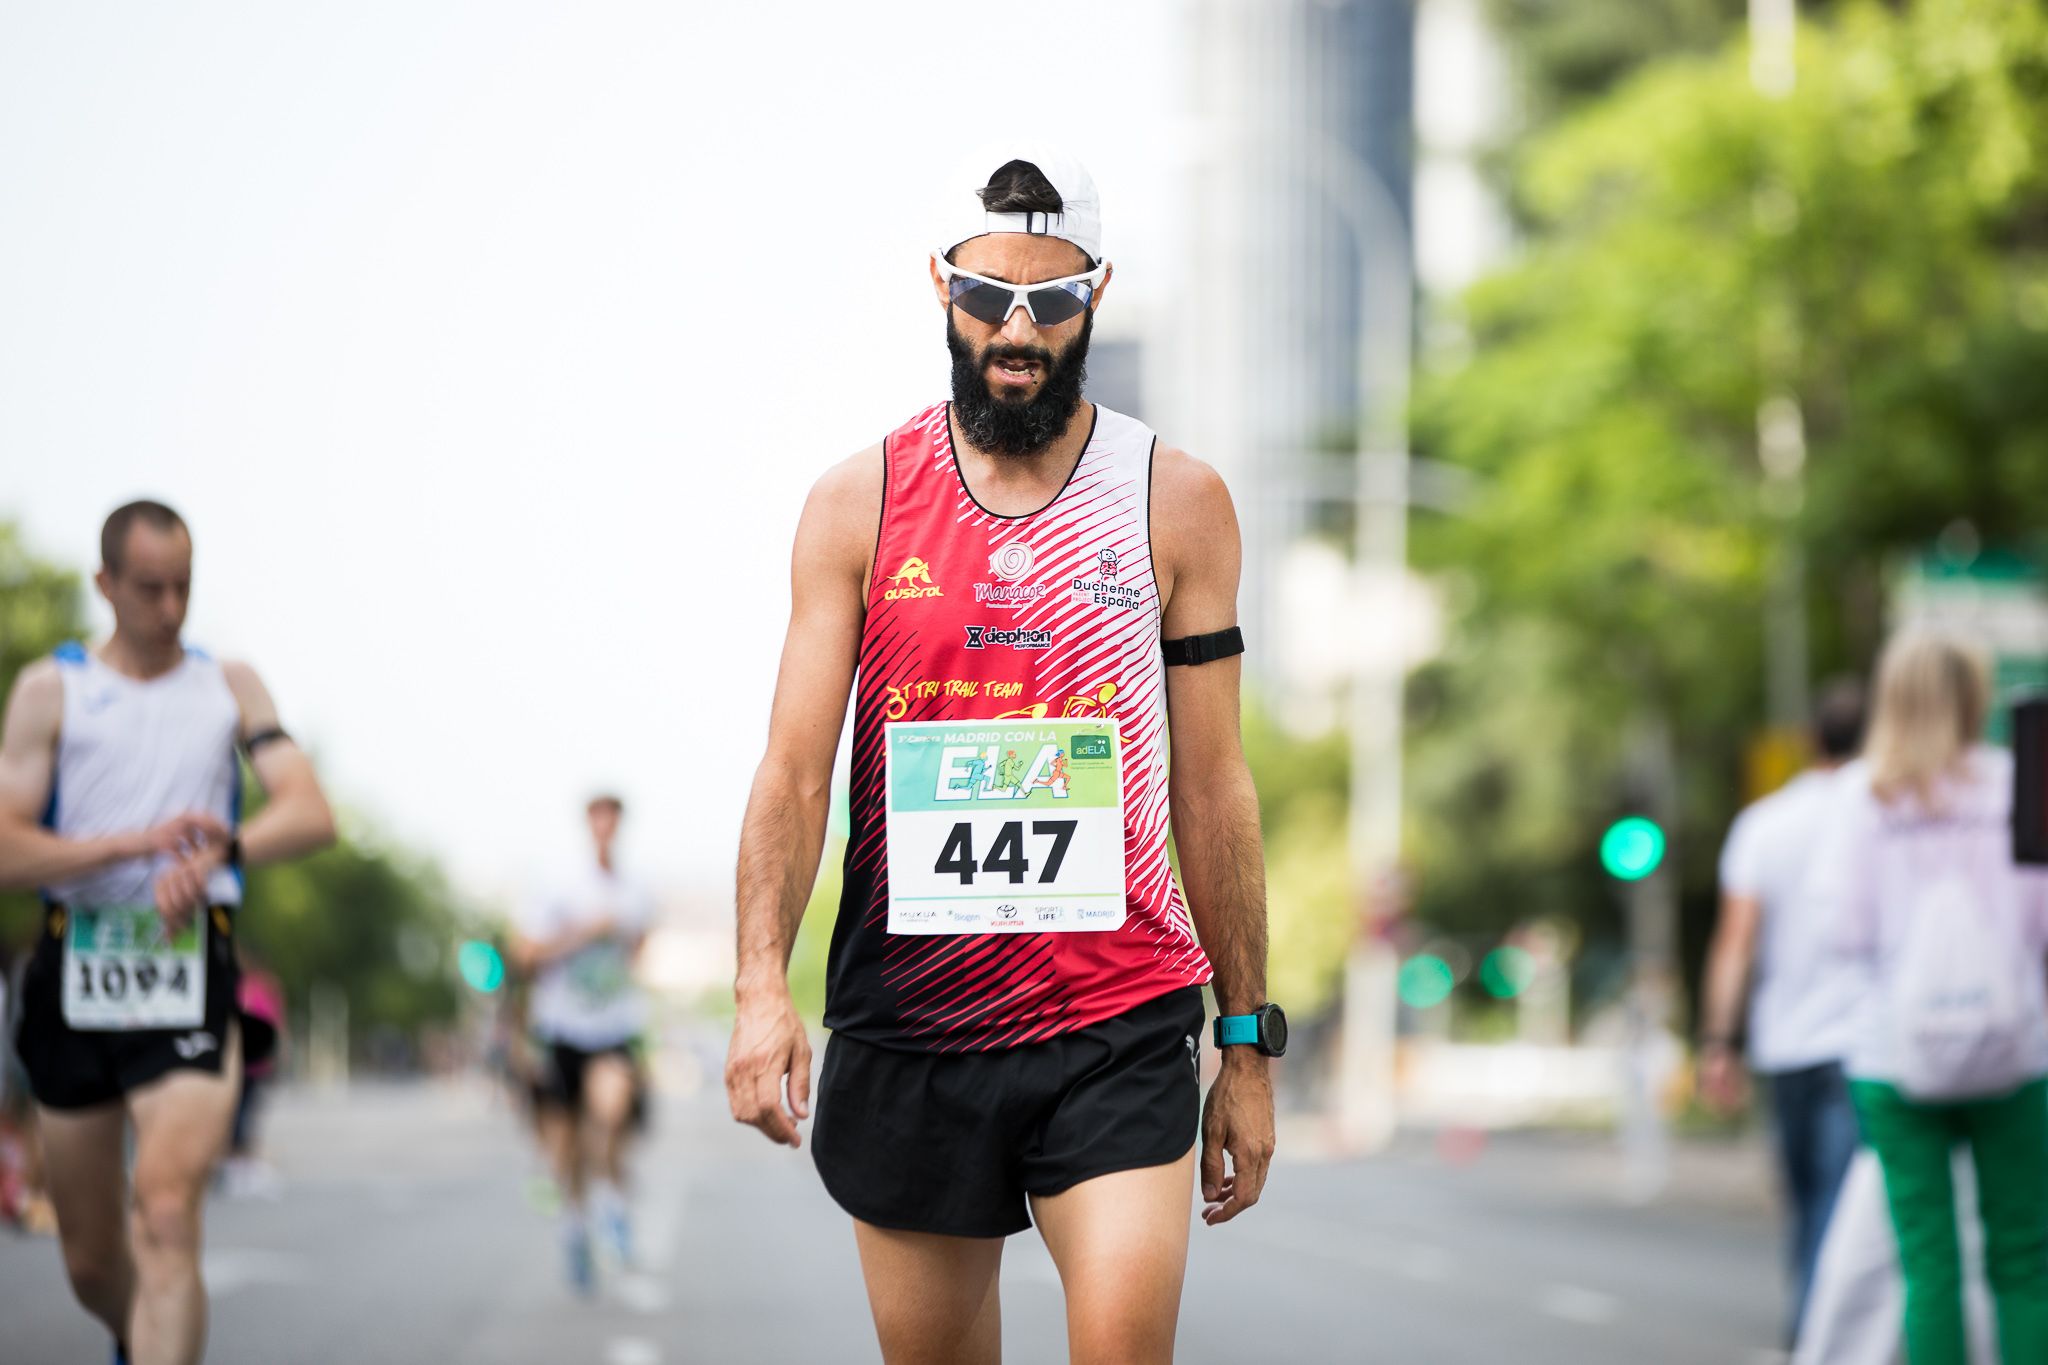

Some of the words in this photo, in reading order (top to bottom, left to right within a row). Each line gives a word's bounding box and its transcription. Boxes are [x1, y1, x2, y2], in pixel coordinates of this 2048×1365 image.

[883, 585, 945, 601] austral
[1073, 579, 1141, 598] Duchenne
[1094, 593, 1139, 610] España
[984, 627, 1051, 645] dephion
[915, 681, 941, 699] TRI
[944, 680, 978, 697] TRAIL
[984, 681, 1024, 699] TEAM
[944, 731, 1001, 744] MADRID
[1004, 731, 1036, 742] CON
[1039, 730, 1057, 741] LA
[1075, 745, 1107, 755] adELA
[934, 744, 1069, 801] ELA
[934, 819, 1079, 885] 447
[1035, 905, 1058, 914] SPORT
[1085, 910, 1116, 918] MADRID
[79, 960, 189, 1000] 1094
